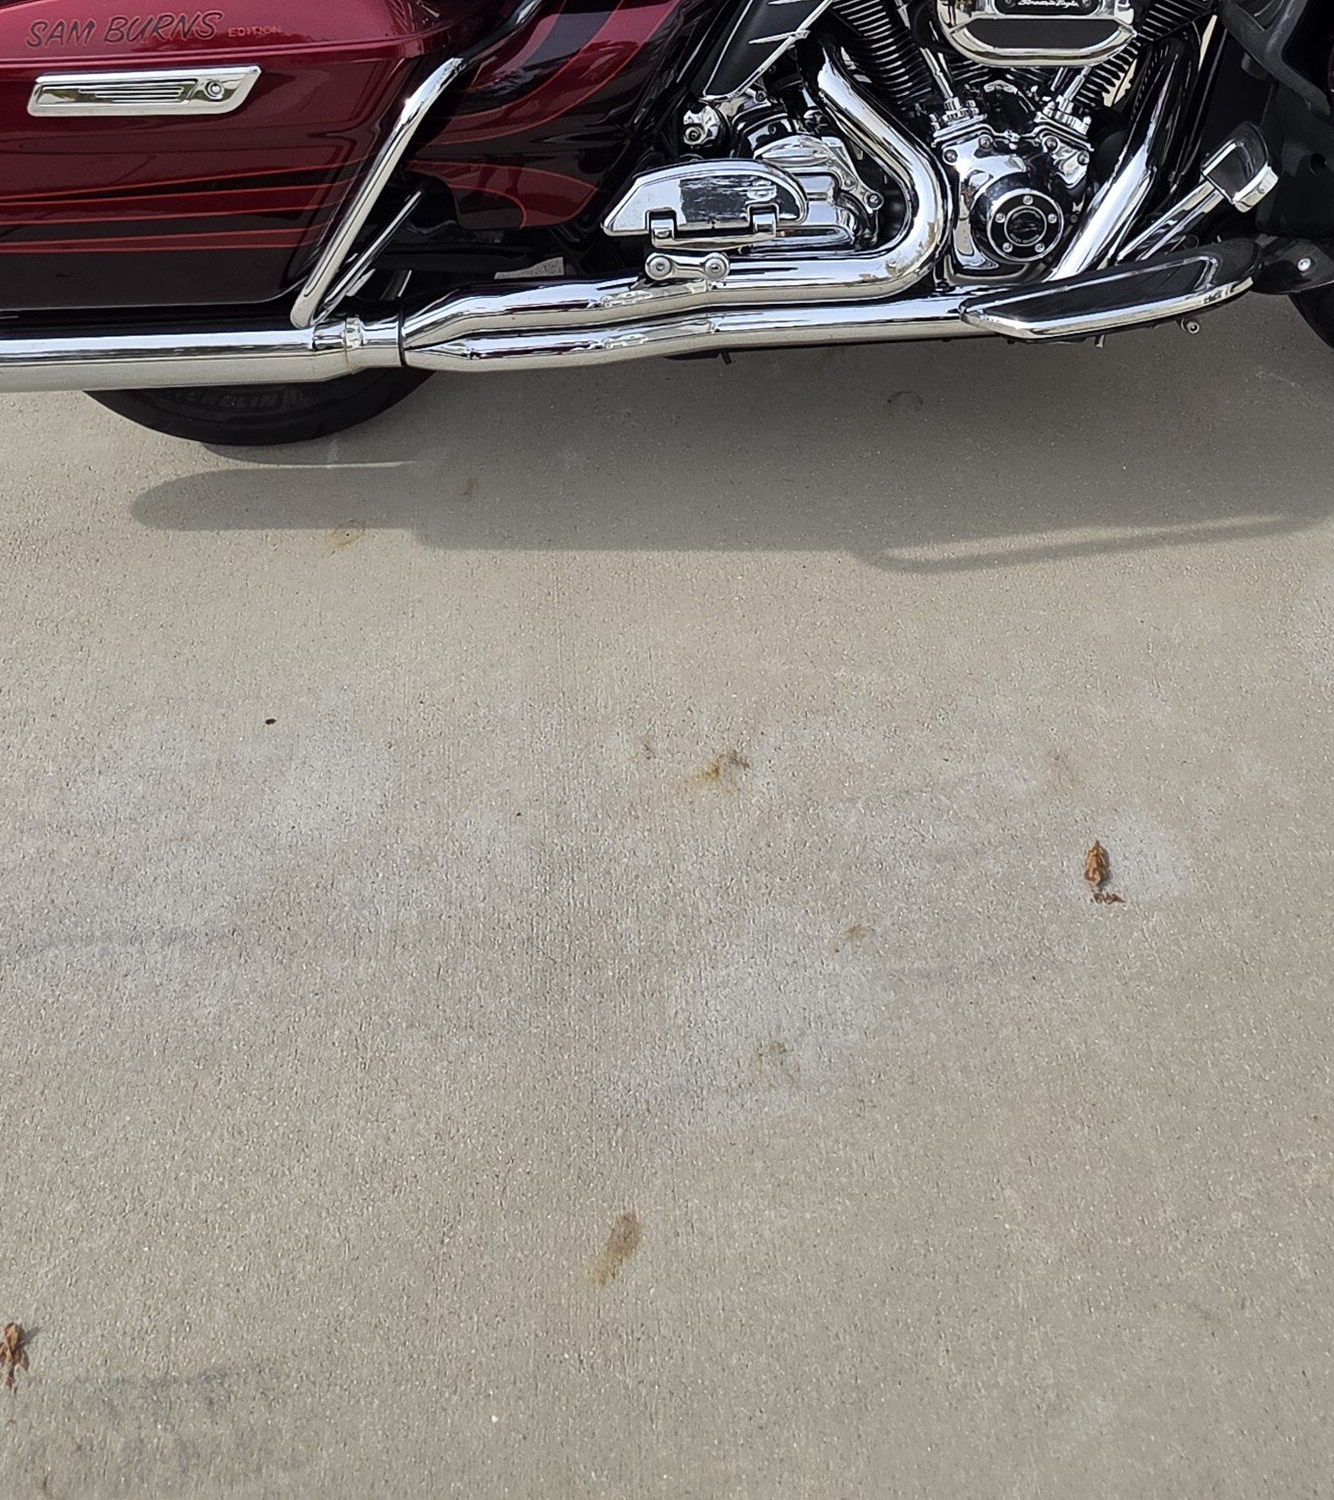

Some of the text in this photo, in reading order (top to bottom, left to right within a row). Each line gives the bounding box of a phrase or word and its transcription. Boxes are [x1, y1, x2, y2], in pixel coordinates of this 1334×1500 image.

[27, 10, 282, 48] SAM BURNS EDITION
